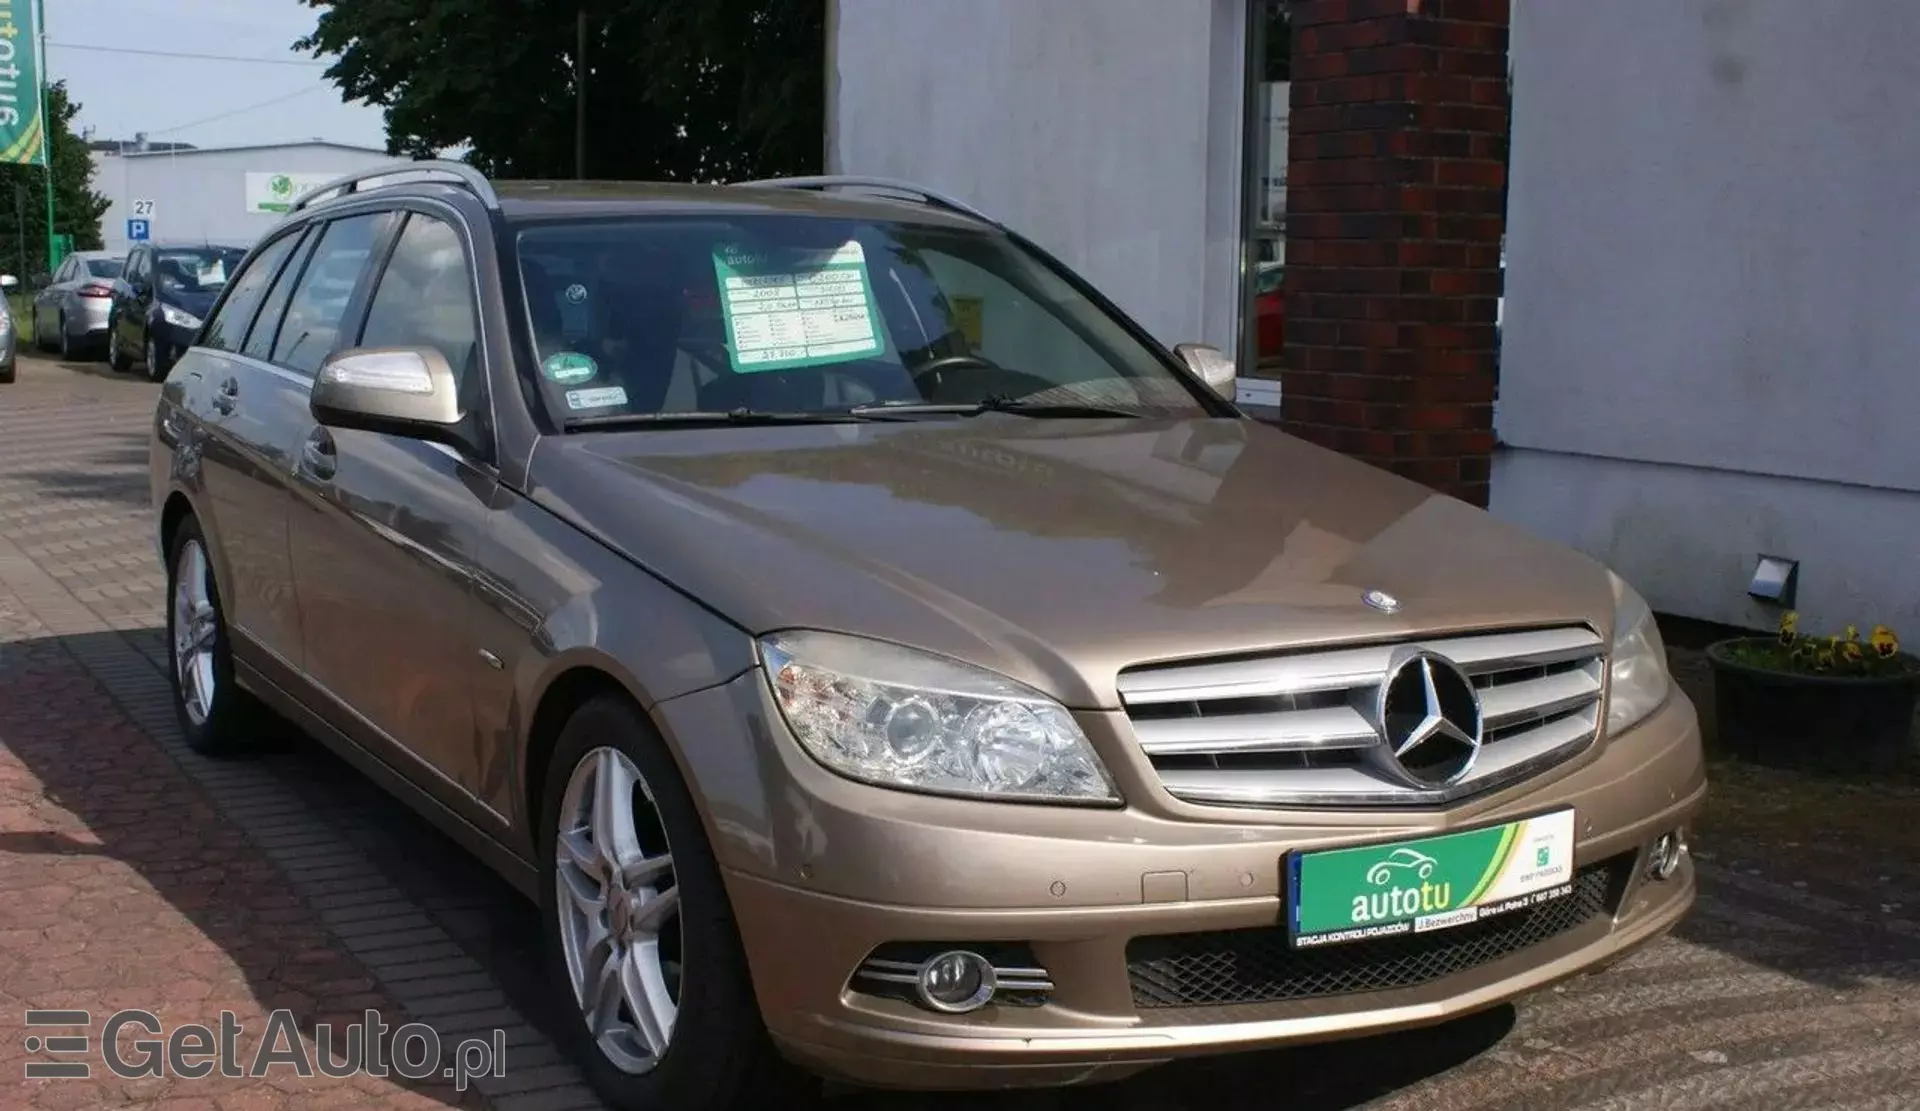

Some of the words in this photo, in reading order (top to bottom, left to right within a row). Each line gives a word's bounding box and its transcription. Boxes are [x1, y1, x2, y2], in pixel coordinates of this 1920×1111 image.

[135, 201, 153, 214] 27
[131, 221, 145, 238] P
[1351, 878, 1451, 923] autotu
[1296, 935, 1328, 947] STACJA
[1328, 929, 1367, 942] KONTROLI
[1367, 921, 1411, 937] POJAZDÓW
